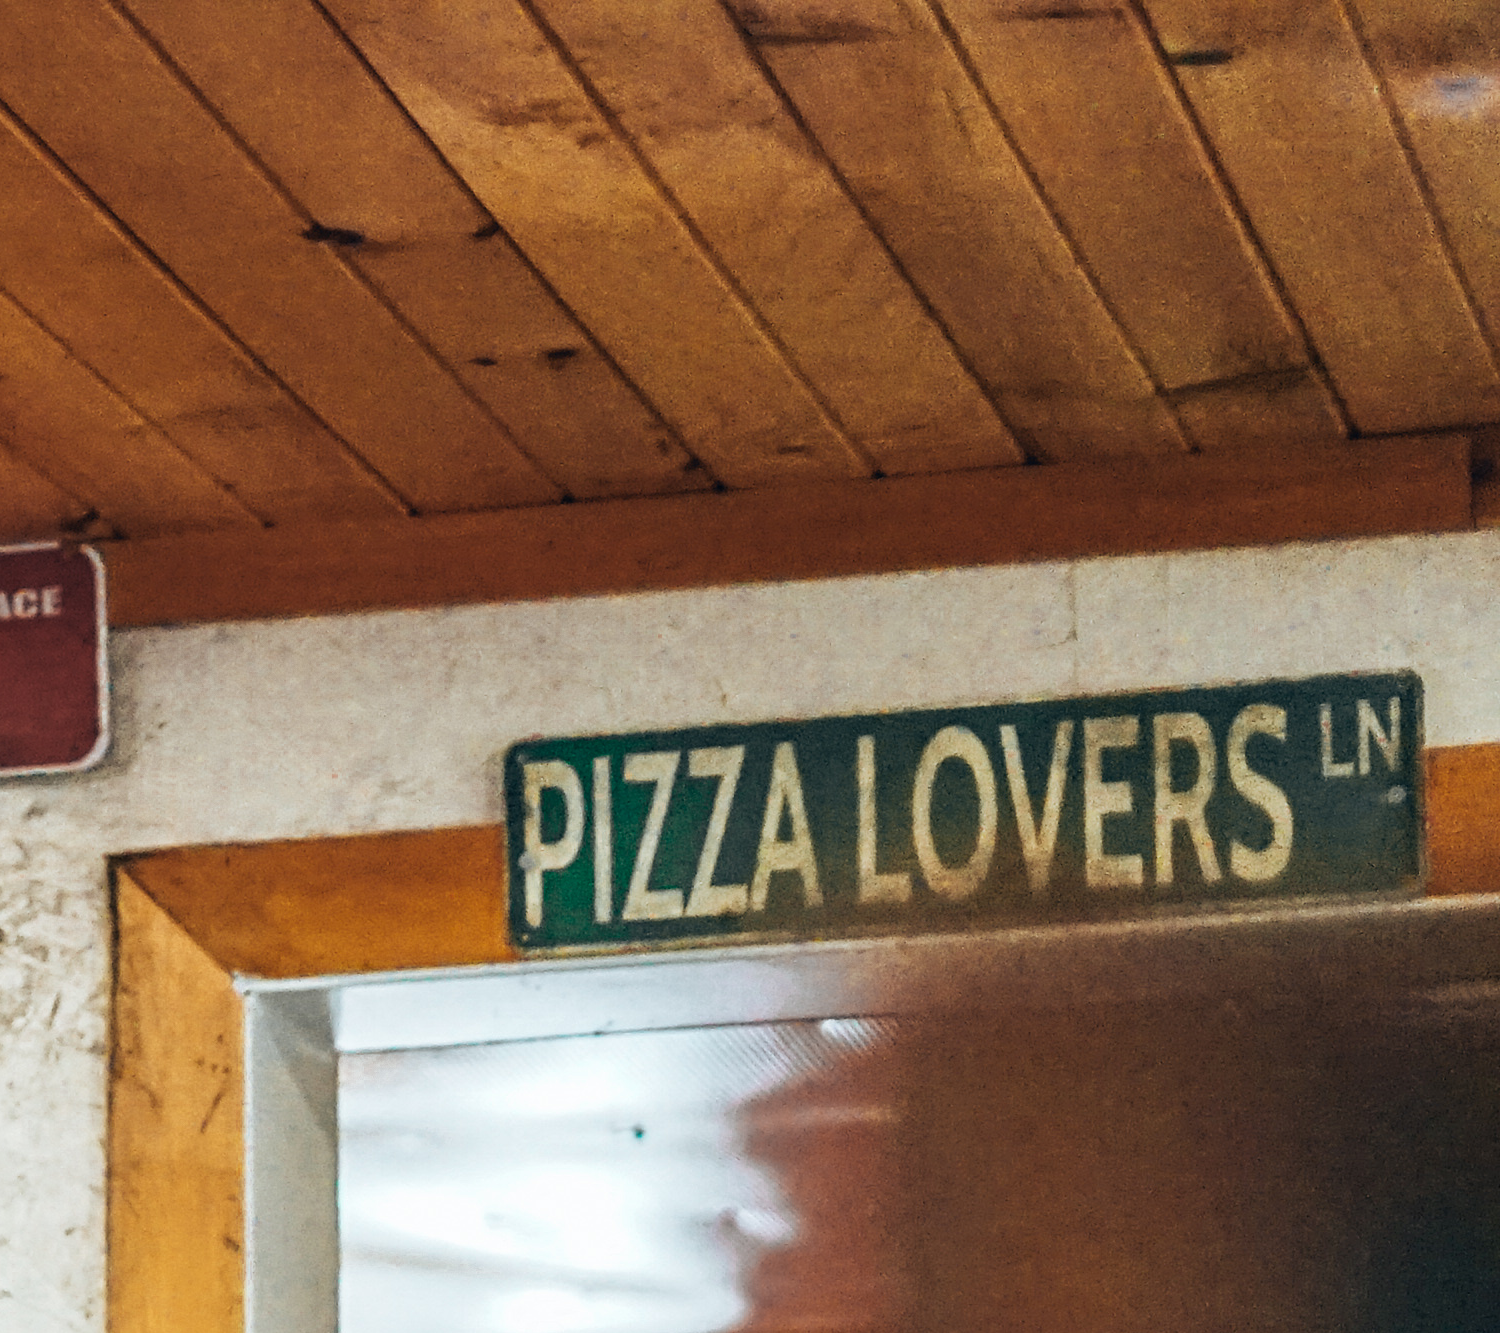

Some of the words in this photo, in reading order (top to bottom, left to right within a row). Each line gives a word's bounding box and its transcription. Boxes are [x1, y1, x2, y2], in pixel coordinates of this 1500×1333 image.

[519, 740, 825, 930] PIZZA
[855, 702, 1296, 906] LOVERS
[1320, 695, 1403, 779] LN
